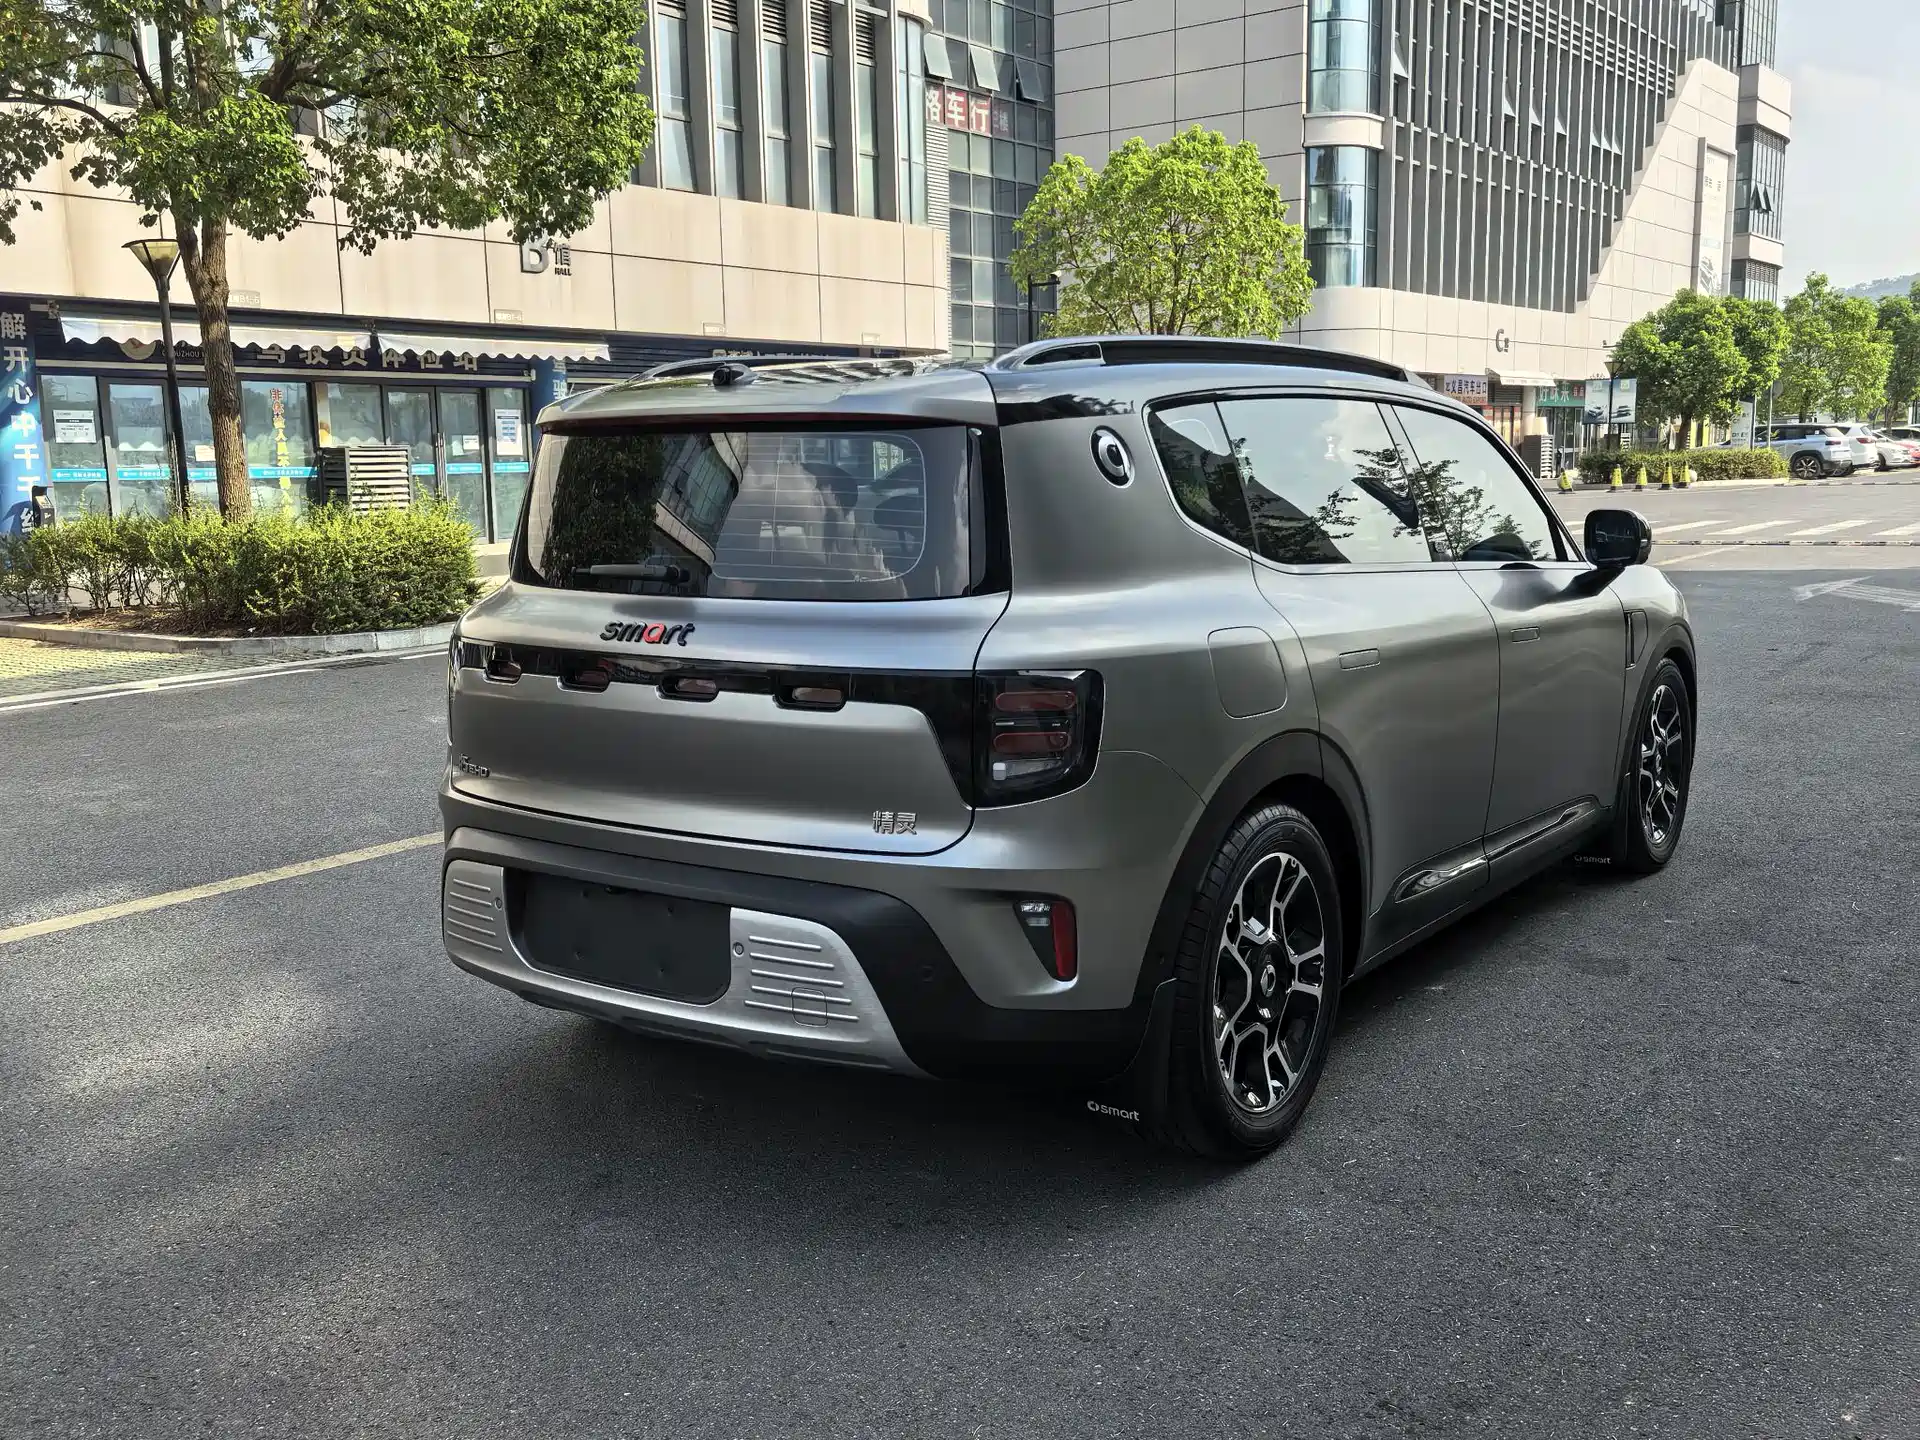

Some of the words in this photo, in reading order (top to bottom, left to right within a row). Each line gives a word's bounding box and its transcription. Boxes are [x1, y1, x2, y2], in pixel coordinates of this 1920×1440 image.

[600, 621, 696, 647] smart
[872, 810, 917, 835] 精灵
[1583, 856, 1611, 864] smart
[1100, 1104, 1140, 1121] smart
